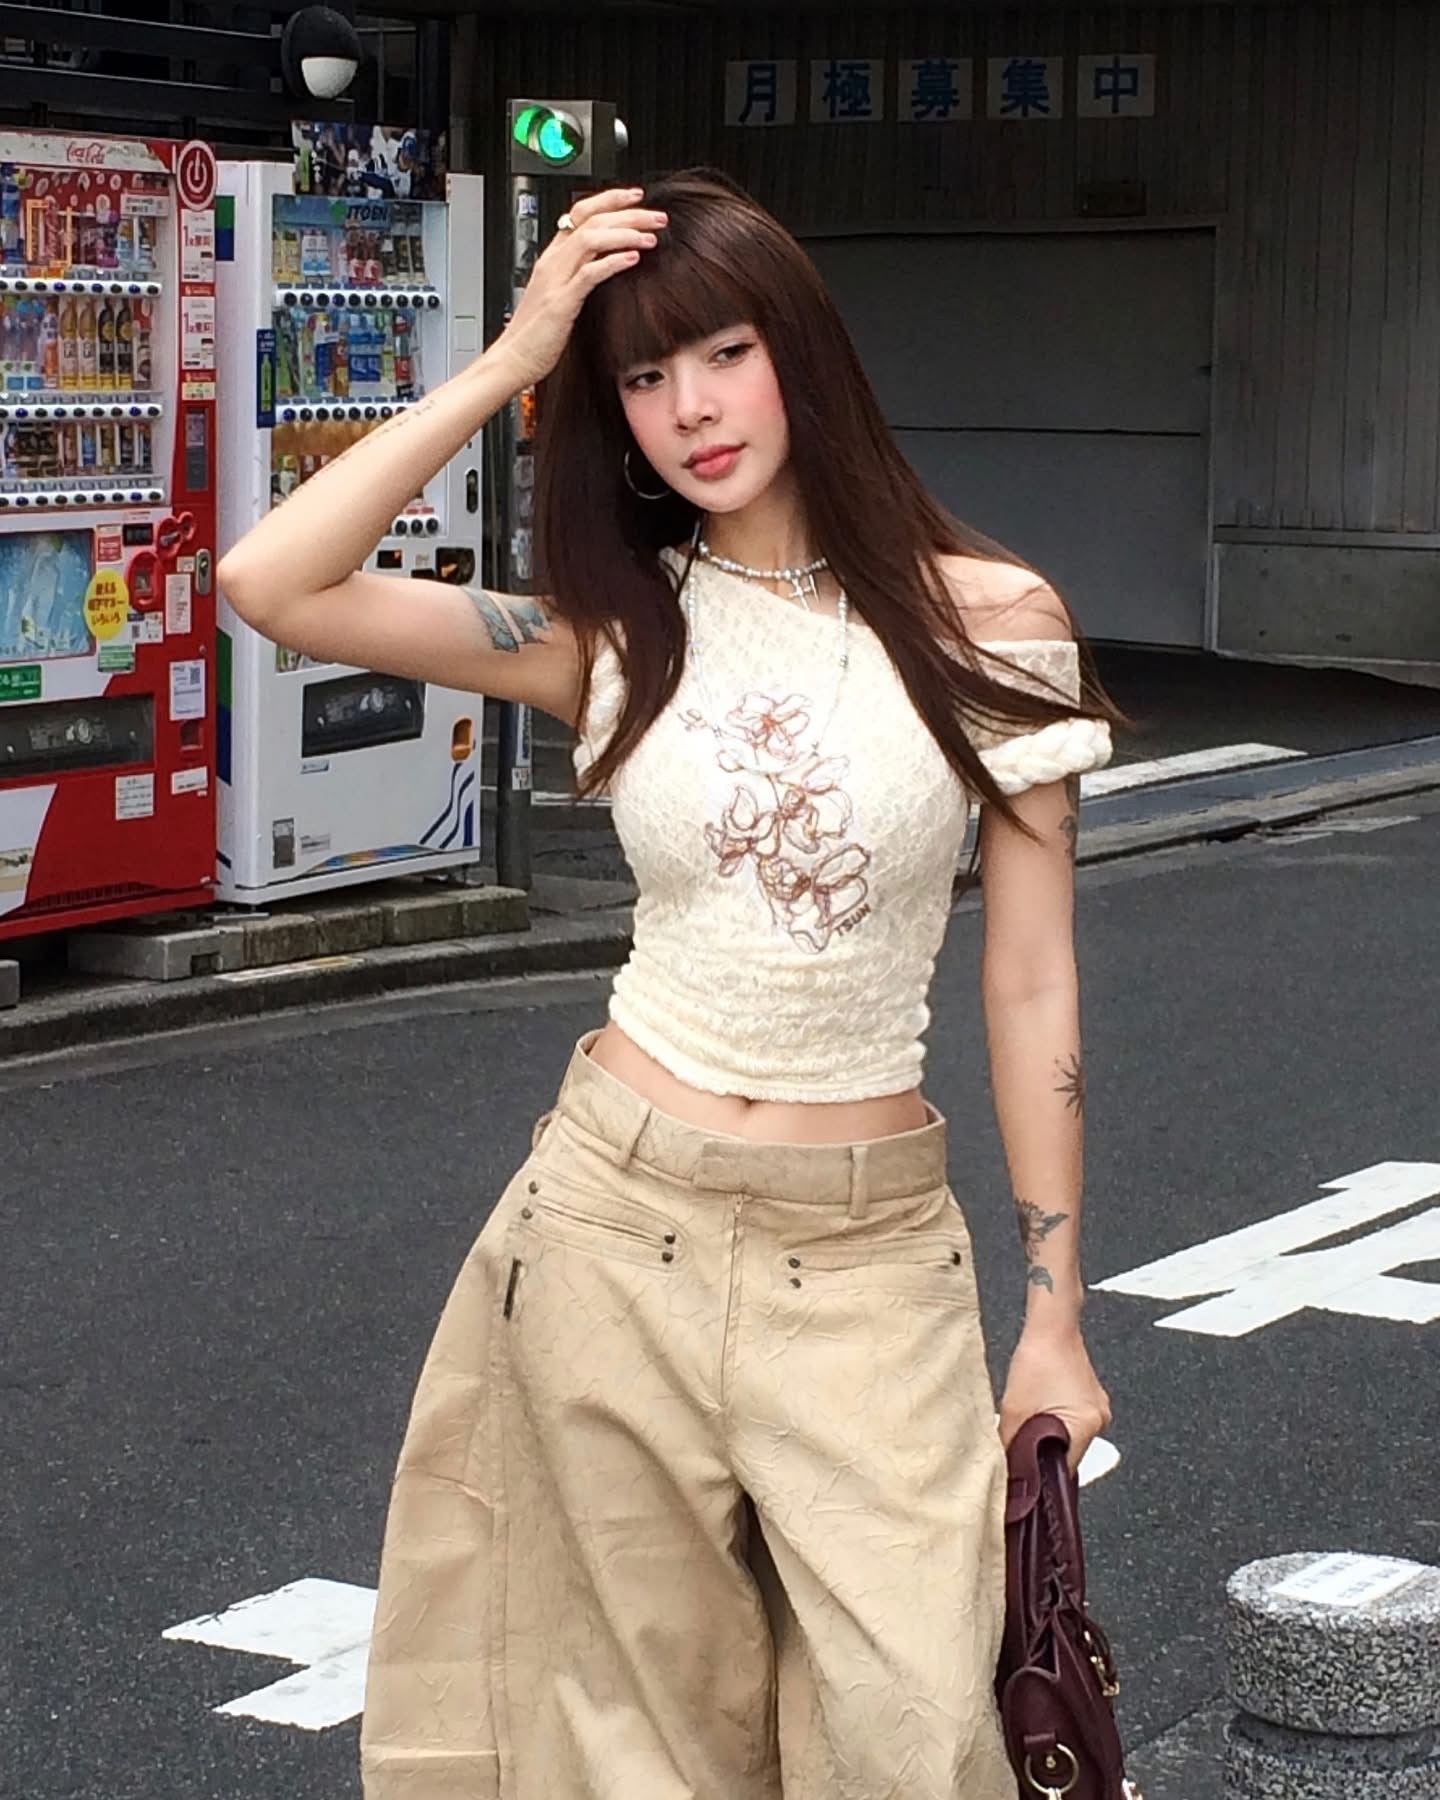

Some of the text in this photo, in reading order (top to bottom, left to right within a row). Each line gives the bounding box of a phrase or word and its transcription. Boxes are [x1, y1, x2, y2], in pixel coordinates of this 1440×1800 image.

[739, 56, 1139, 122] 月極募集中
[833, 903, 872, 937] TSUN
